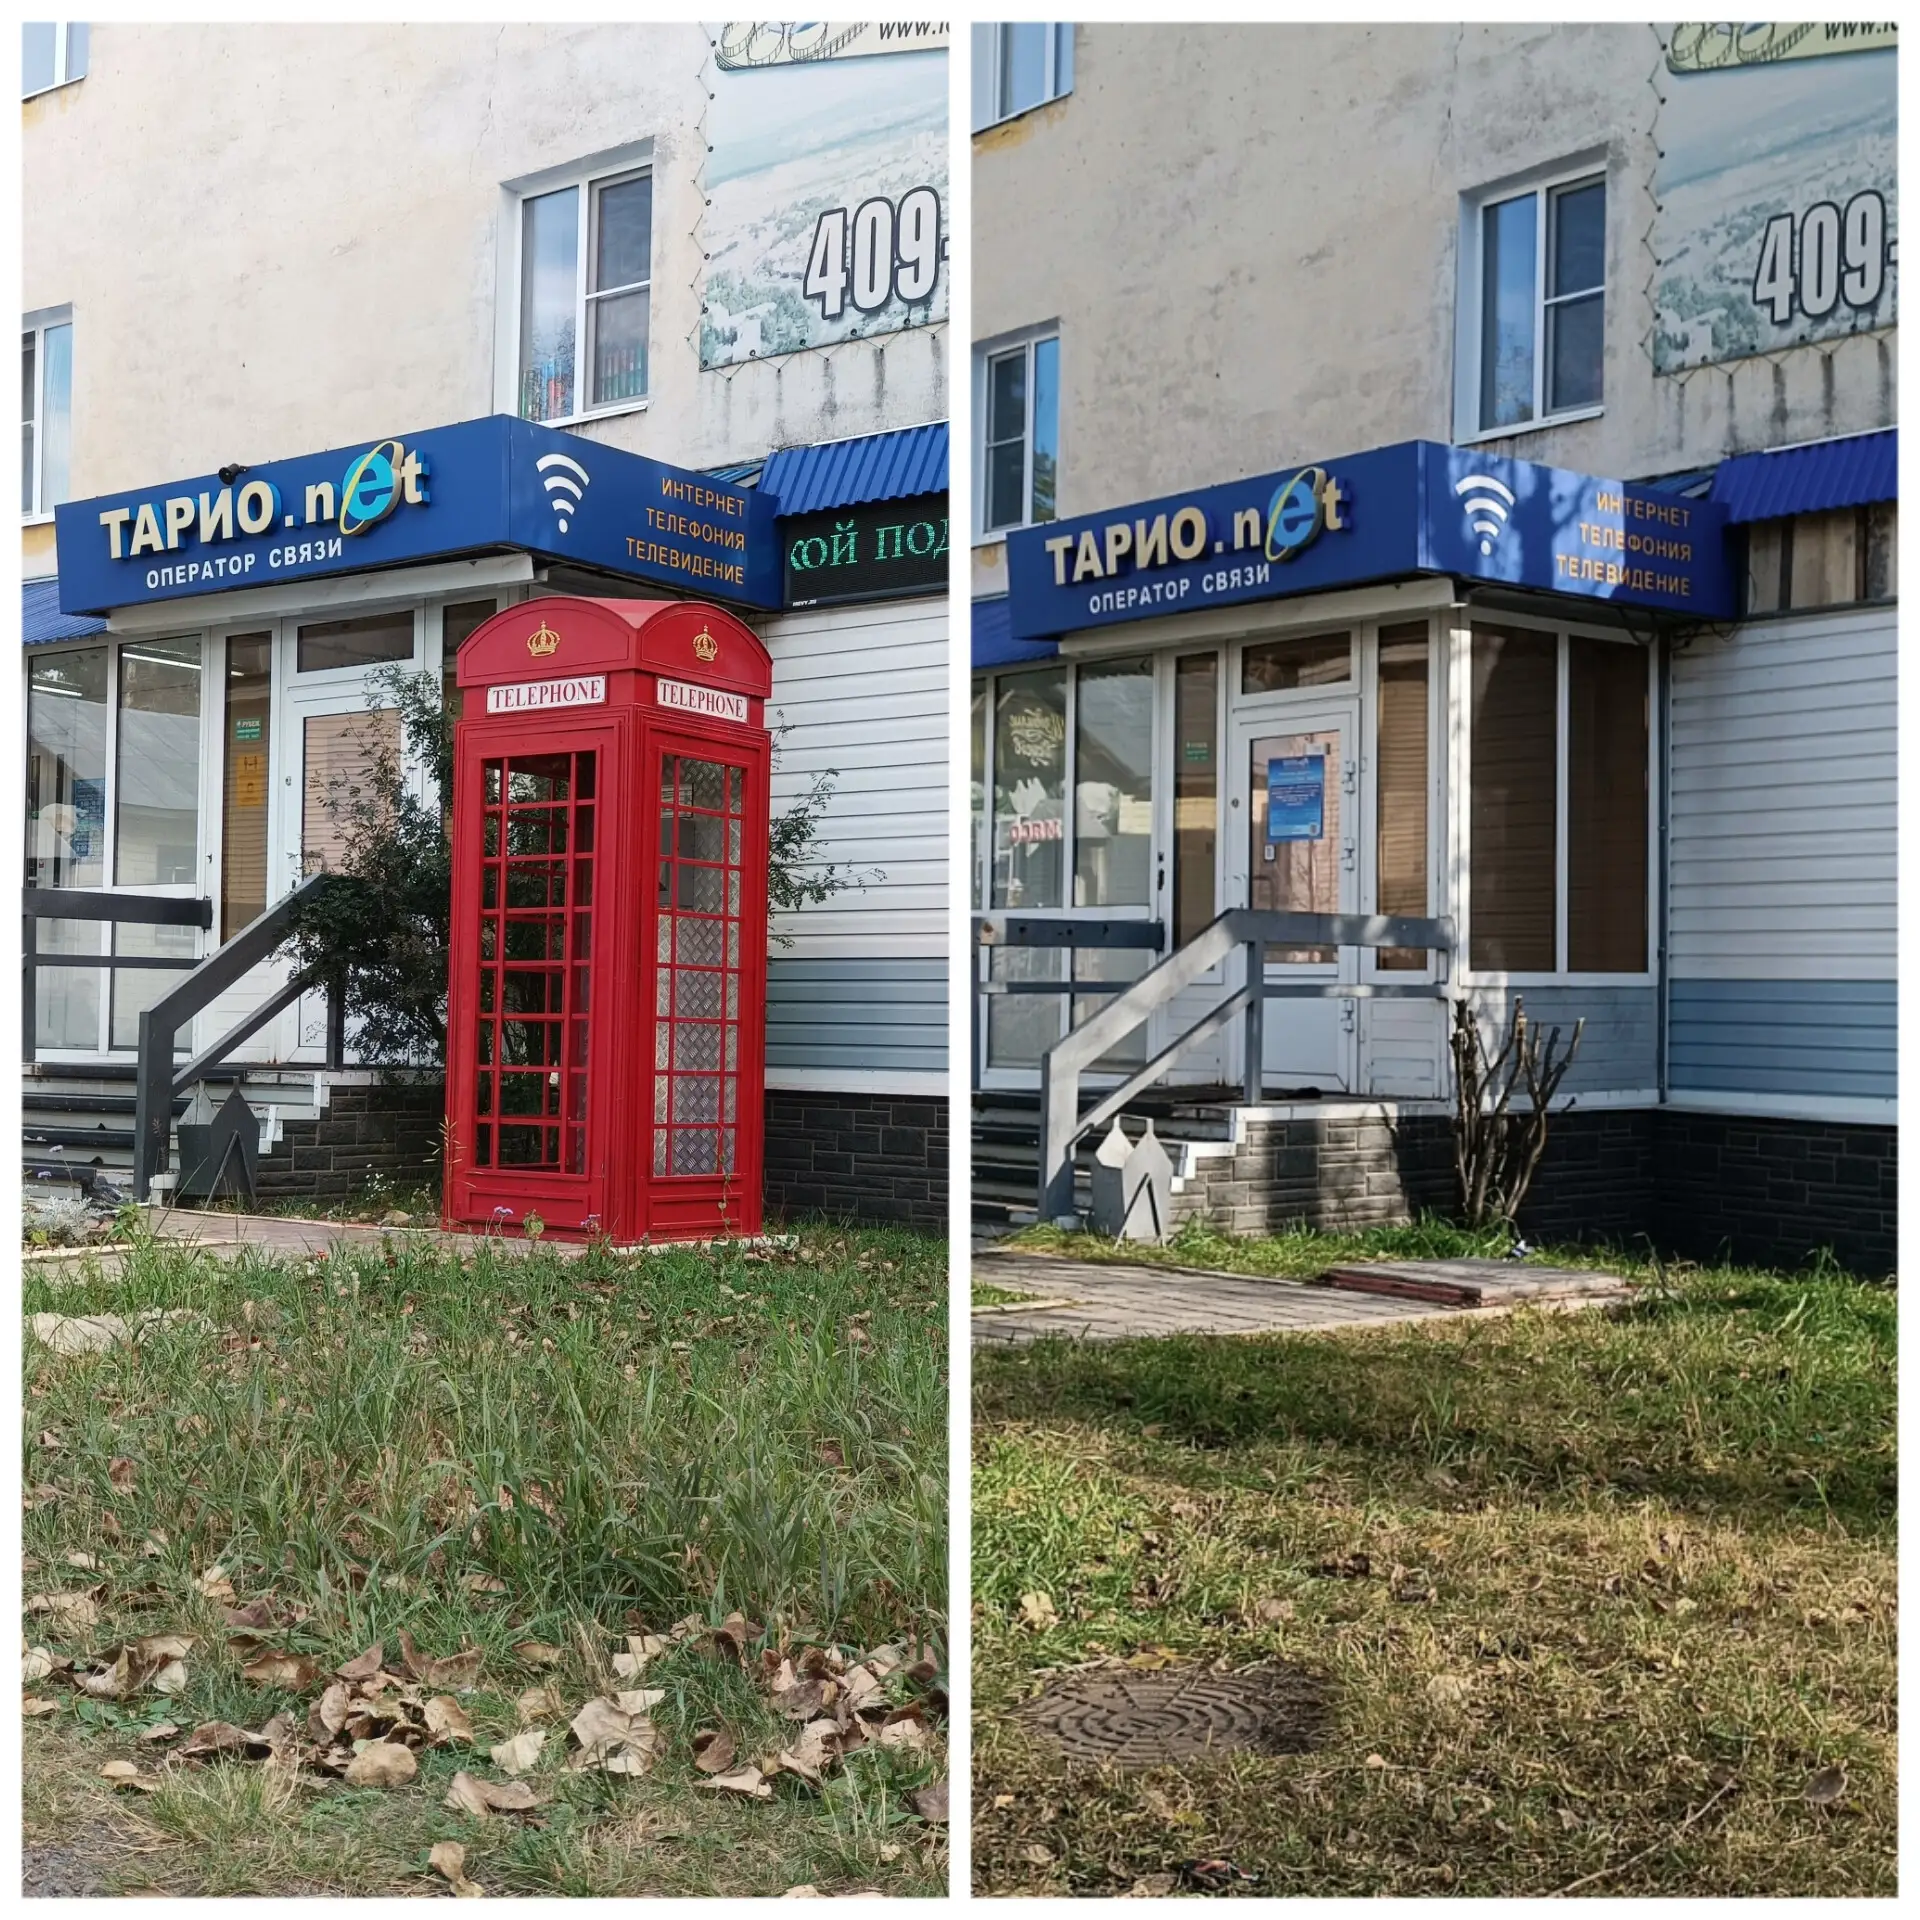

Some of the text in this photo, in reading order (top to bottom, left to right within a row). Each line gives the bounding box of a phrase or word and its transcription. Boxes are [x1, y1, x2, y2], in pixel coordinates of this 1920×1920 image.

[661, 476, 745, 518] ИНТЕРНЕТ
[1597, 491, 1690, 529] ИНТЕРНЕТ
[646, 507, 745, 551] ТЕЛЕФОНИЯ
[1579, 521, 1691, 562] ТЕЛЕФОНИЯ
[146, 537, 343, 589] ОПЕРАТОР СВЯЗИ
[625, 537, 745, 585] ТЕЛЕВИДЕНИЕ
[1556, 553, 1691, 596] ТЕЛЕВИДЕНИЕ
[1089, 563, 1271, 614] ОПЕРАТОР СВЯЗИ
[493, 680, 601, 709] TELEPHONE
[660, 683, 744, 718] TELEPHONE
